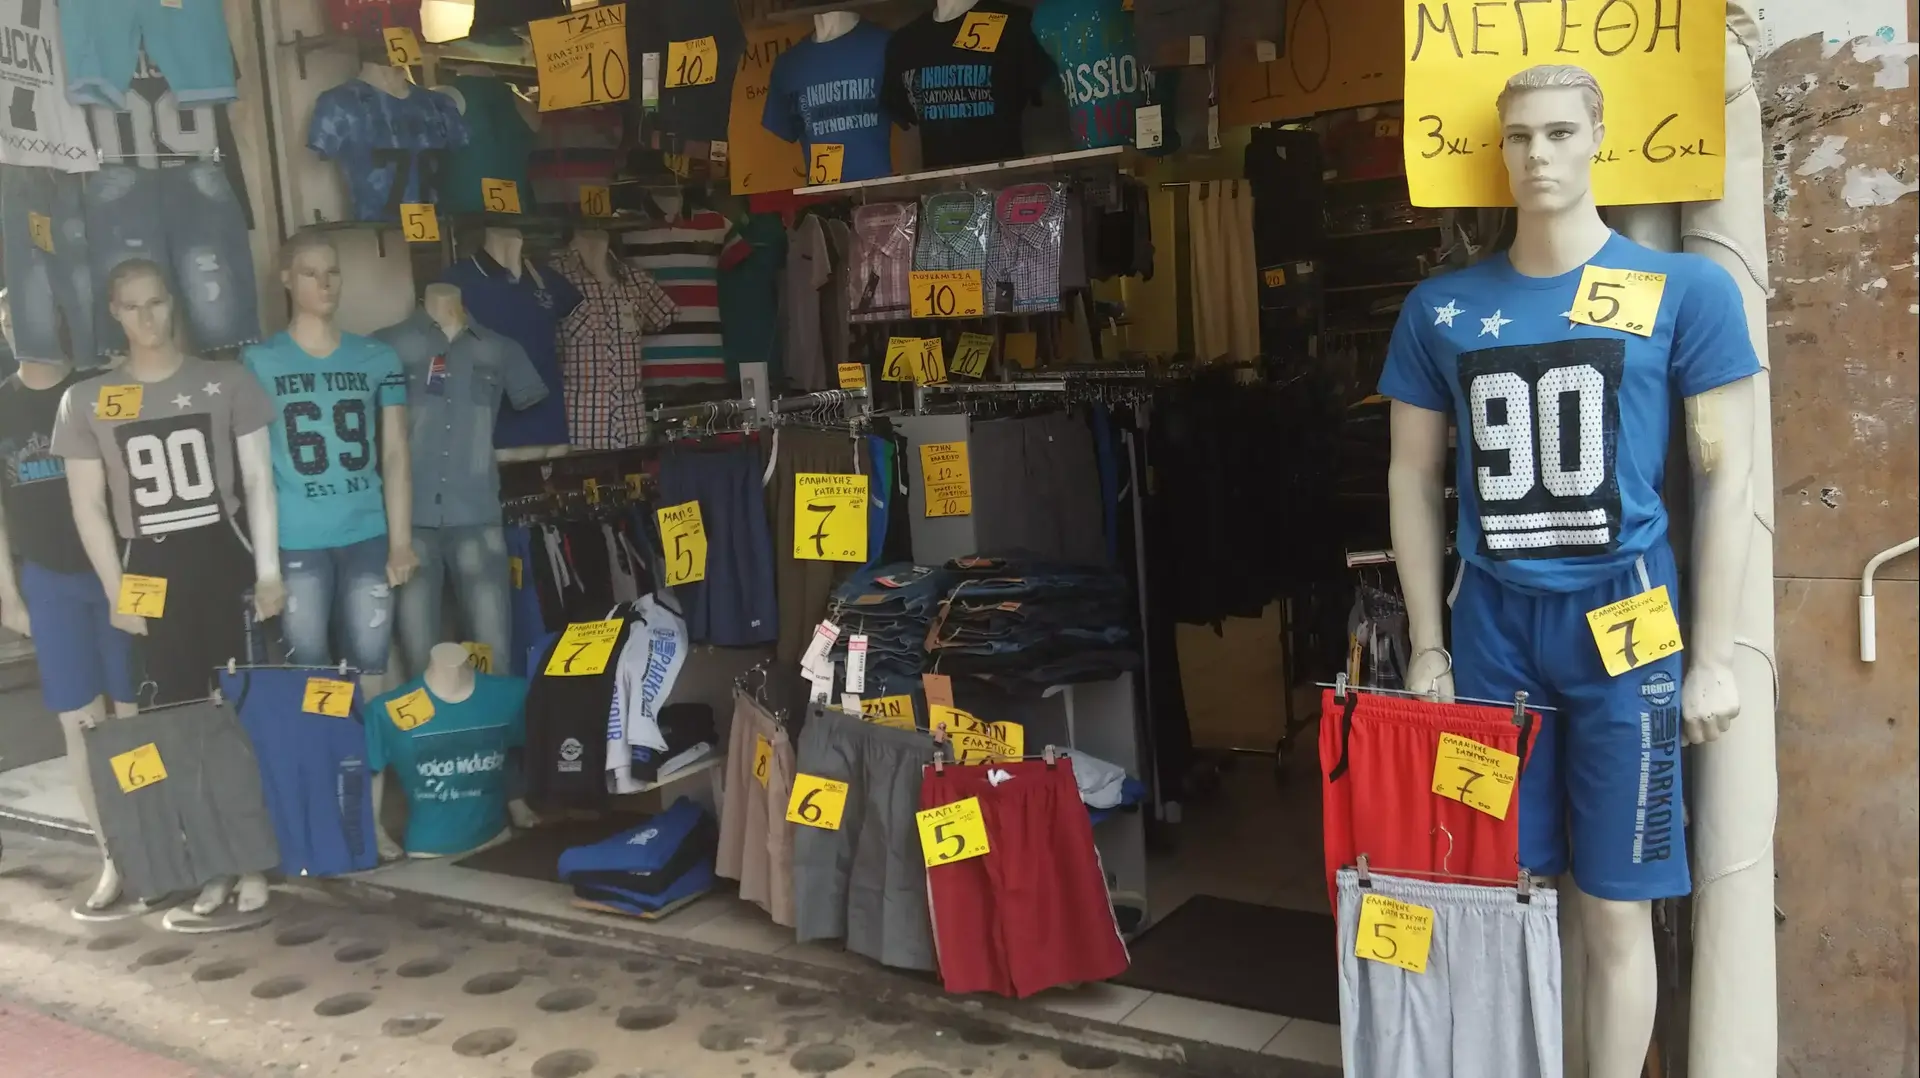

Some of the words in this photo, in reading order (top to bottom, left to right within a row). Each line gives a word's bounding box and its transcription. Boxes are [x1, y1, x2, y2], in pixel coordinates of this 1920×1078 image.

[389, 37, 409, 63] 5
[964, 22, 991, 49] 5
[581, 49, 628, 104] 10
[674, 55, 704, 86] 10
[816, 153, 829, 184] 5
[489, 187, 506, 212] 5
[409, 213, 425, 240] 5
[925, 284, 956, 316] 10
[1587, 281, 1626, 325] 5
[888, 351, 905, 379] 6
[920, 351, 939, 385] 10
[958, 347, 982, 375] 10
[273, 373, 315, 397] NEW
[322, 372, 370, 394] YORK
[105, 394, 124, 417] 5
[283, 399, 371, 476] 69
[1470, 363, 1606, 501] 90
[127, 427, 215, 507] 90
[807, 503, 837, 557] 7
[674, 532, 693, 582] 5
[131, 590, 147, 614] 7
[560, 641, 594, 674] 7
[1606, 617, 1641, 669] 7
[313, 690, 333, 713] 7
[396, 697, 418, 727] 5
[129, 760, 146, 787] 6
[756, 754, 767, 778] 8
[1456, 765, 1487, 804] 7
[797, 788, 823, 823] 6
[933, 821, 966, 862] 5
[1371, 922, 1398, 960] 5
